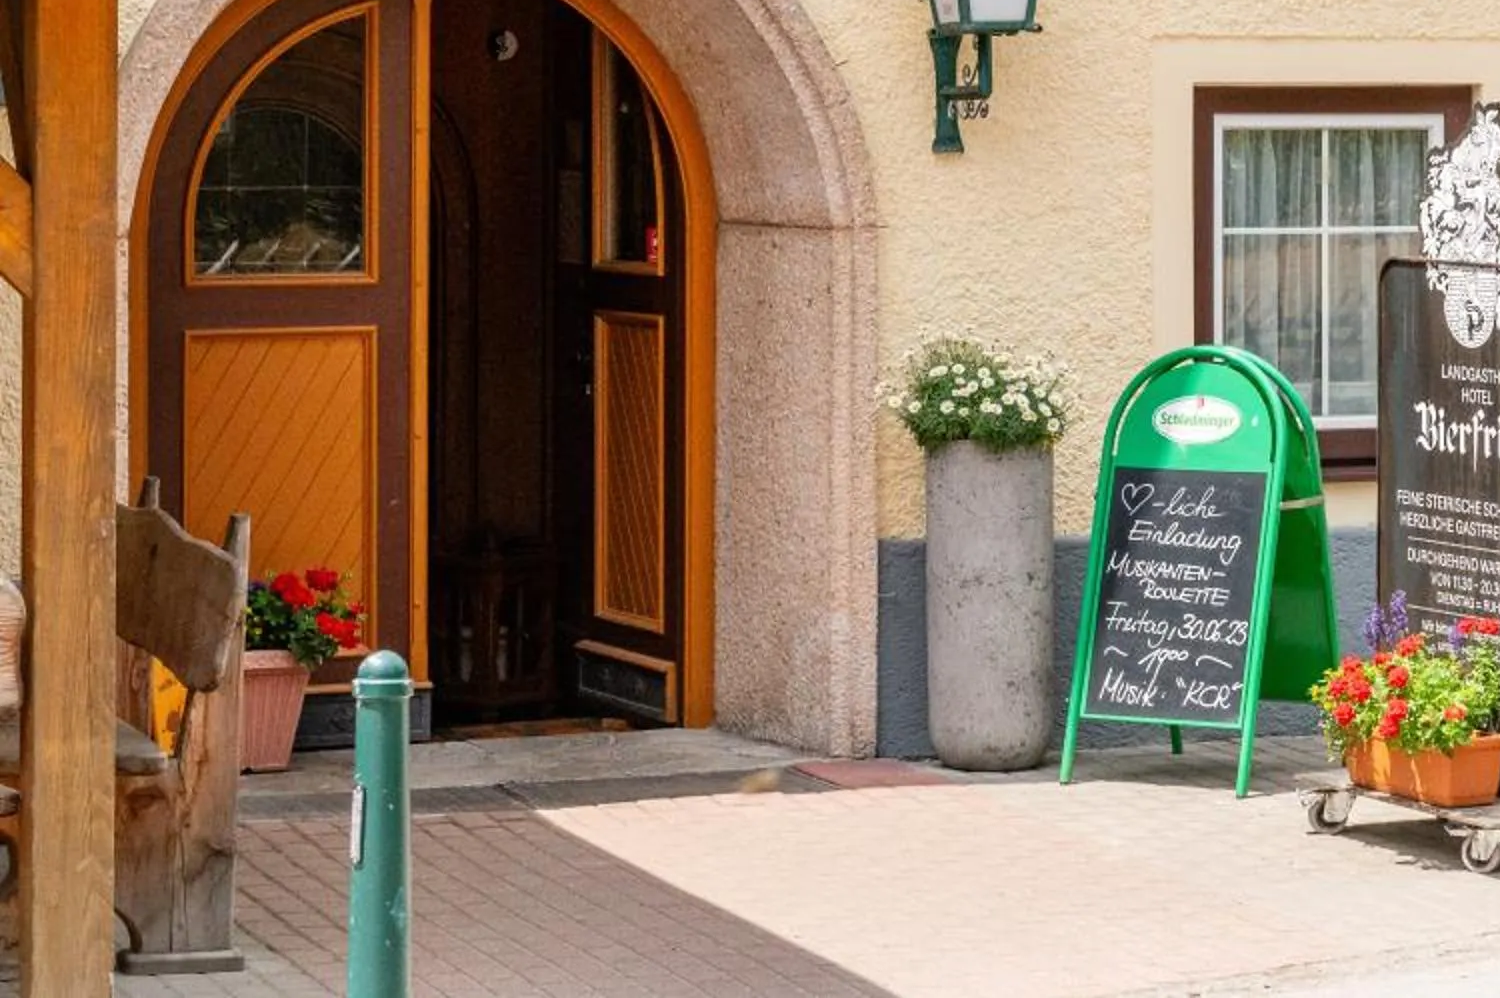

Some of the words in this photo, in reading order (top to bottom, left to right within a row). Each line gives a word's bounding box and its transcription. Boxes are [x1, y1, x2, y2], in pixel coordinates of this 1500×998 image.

[1461, 387, 1494, 406] HOTEL
[1397, 489, 1425, 507] FEINE
[1426, 493, 1481, 516] STEIRISCHE
[1400, 510, 1455, 533] HERZLICHE
[1128, 519, 1242, 566] Einladung
[1407, 547, 1479, 571] DURCHGEHEND
[1139, 577, 1231, 607] ROULETTE
[1430, 571, 1451, 589] VON
